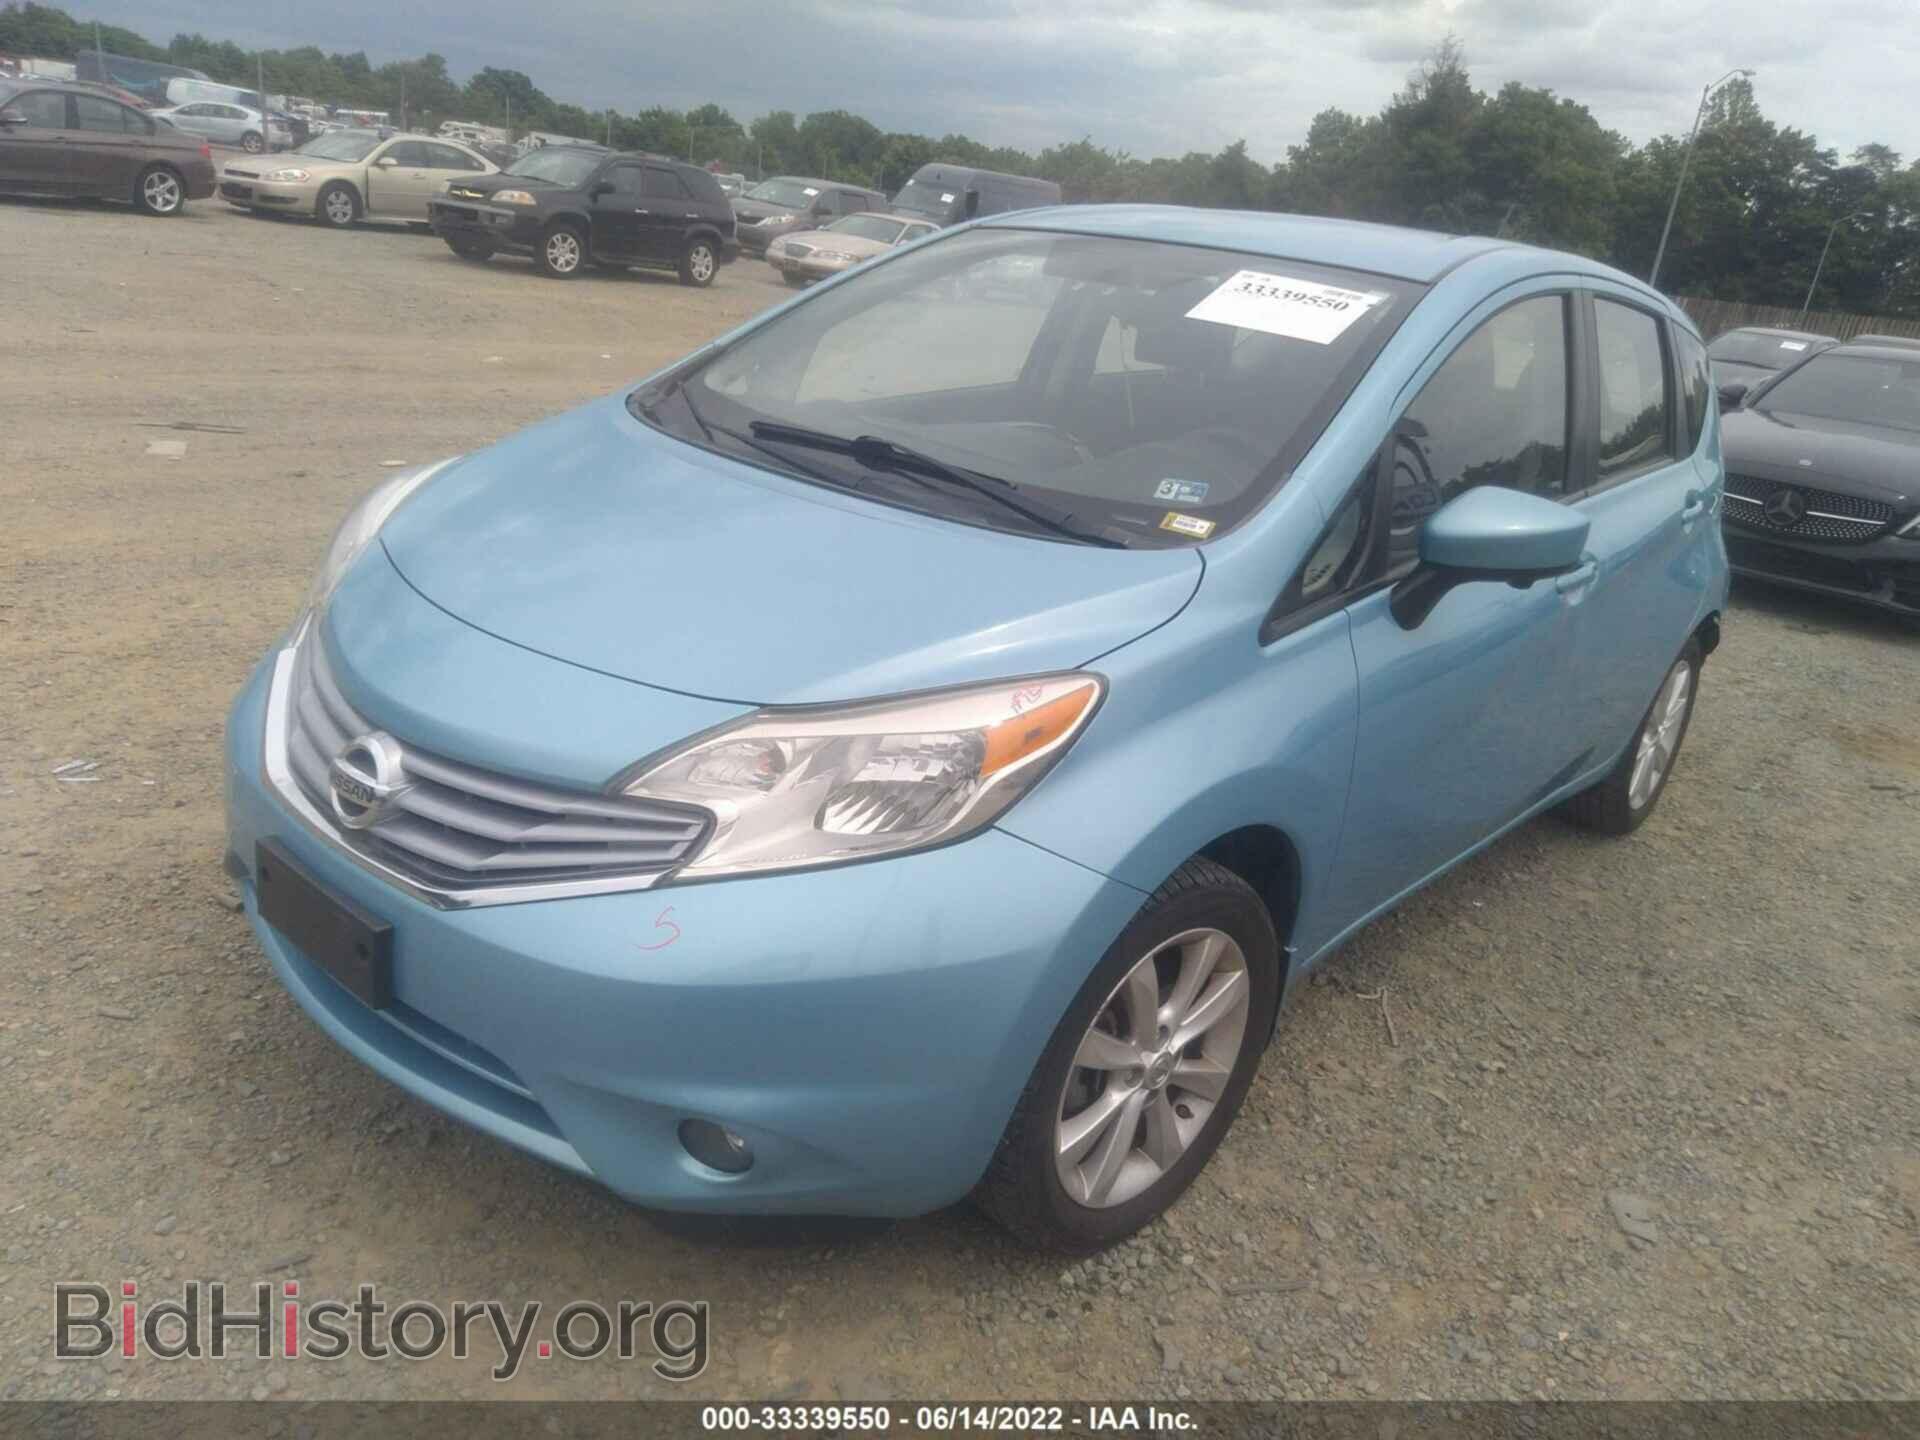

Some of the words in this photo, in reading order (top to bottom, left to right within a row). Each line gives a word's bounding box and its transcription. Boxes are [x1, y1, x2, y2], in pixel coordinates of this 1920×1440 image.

[1234, 282, 1350, 311] 33339550
[1160, 480, 1174, 495] 3
[335, 773, 376, 802] SSAN
